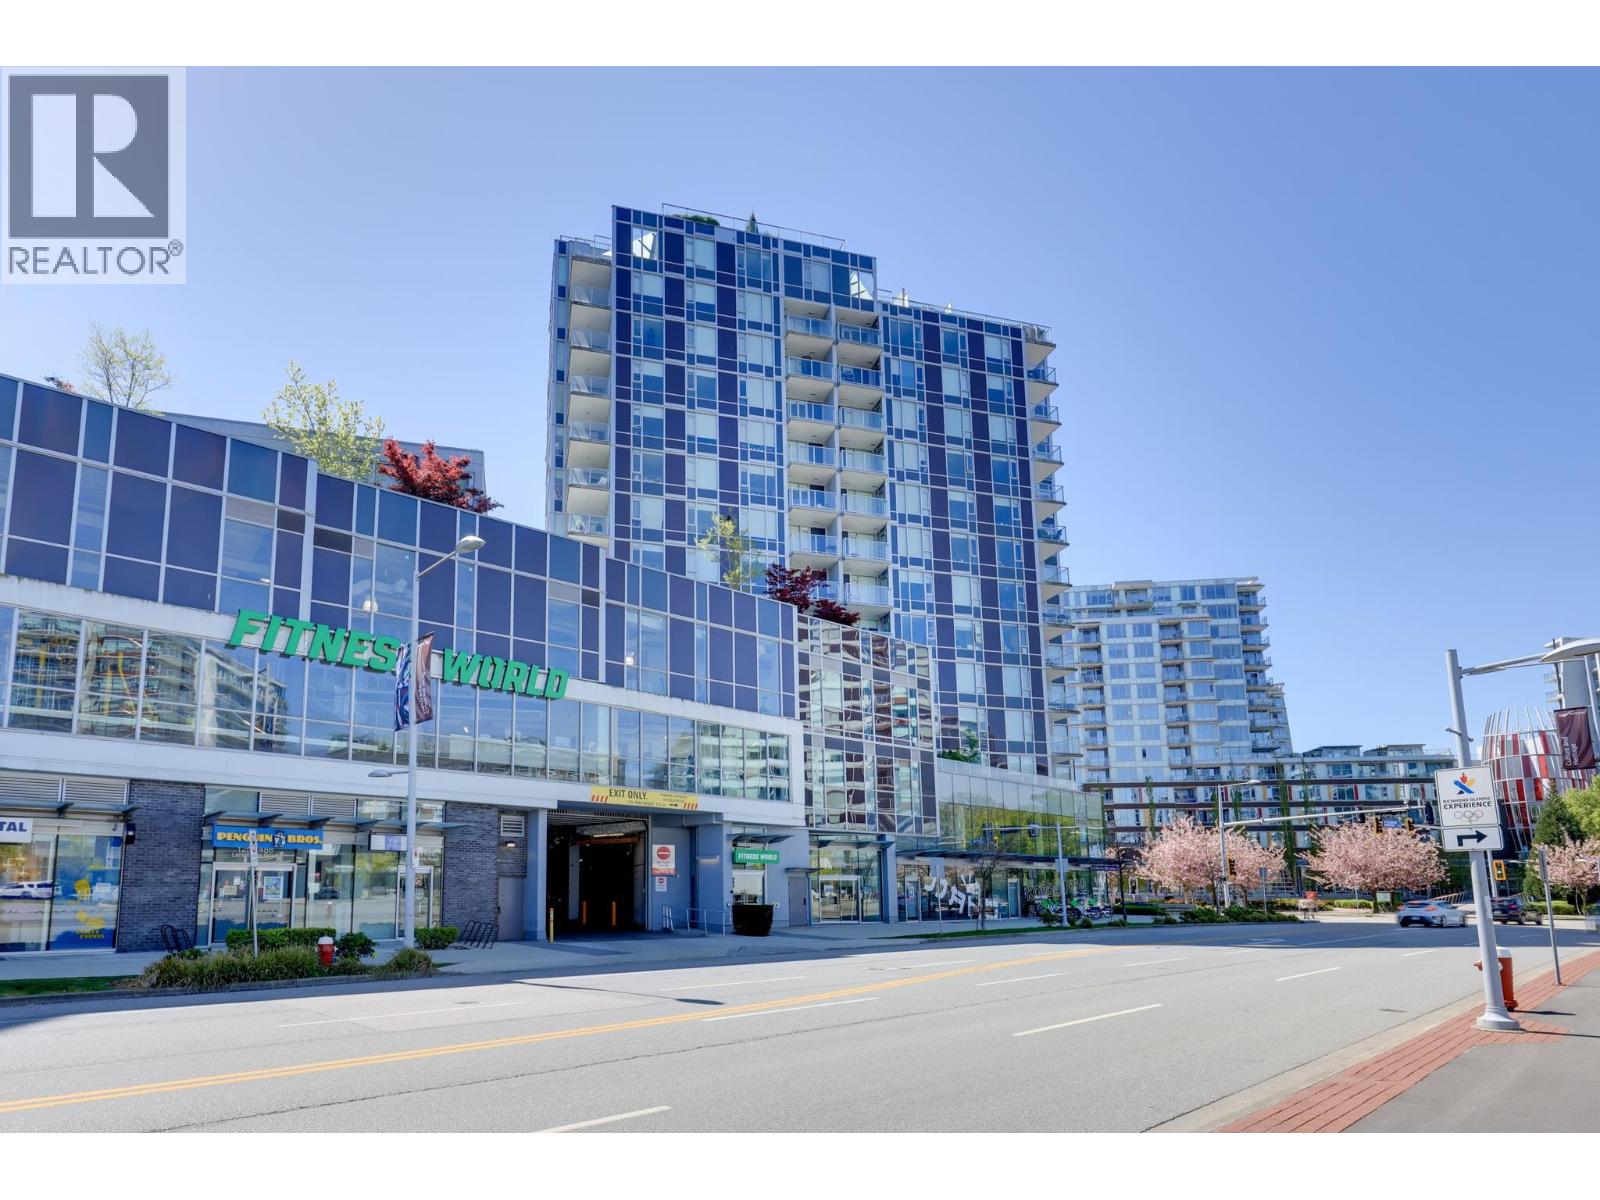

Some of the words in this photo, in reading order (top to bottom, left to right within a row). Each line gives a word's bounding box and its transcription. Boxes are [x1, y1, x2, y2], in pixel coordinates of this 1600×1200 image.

[228, 608, 398, 675] FITNES
[442, 647, 569, 699] WORLD
[609, 788, 626, 798] EXIT
[1443, 800, 1492, 810] EXPERIENCE
[0, 821, 27, 832] TAL
[738, 852, 760, 860] FITNESS
[760, 853, 778, 861] WORLD
